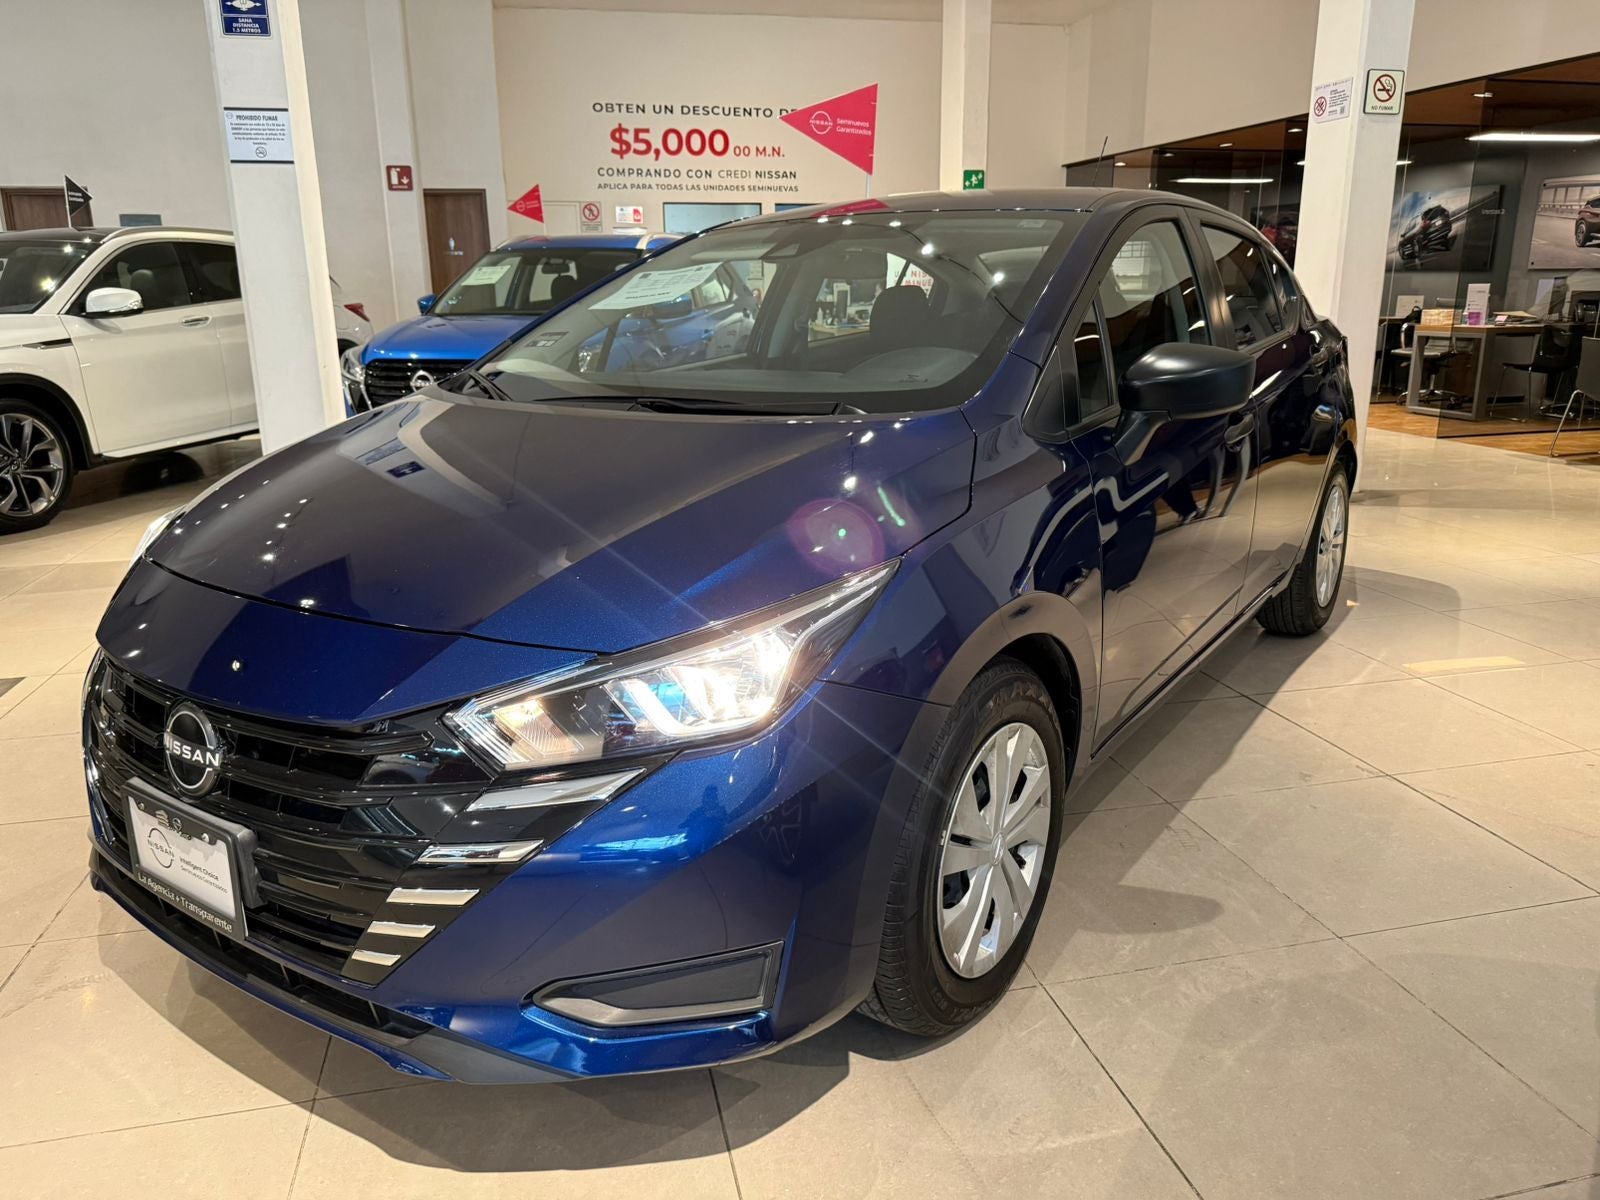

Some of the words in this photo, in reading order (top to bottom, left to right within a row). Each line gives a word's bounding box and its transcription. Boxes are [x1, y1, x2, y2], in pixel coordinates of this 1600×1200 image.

[592, 102, 646, 114] OBTEN
[652, 104, 674, 115] UN
[680, 105, 773, 118] DESCUENTO
[809, 119, 833, 127] NISSAN
[836, 118, 870, 128] Seminuevos
[836, 126, 872, 136] Garantizados
[609, 122, 730, 161] $5,000
[733, 145, 750, 157] 00
[755, 145, 785, 157] M.N.
[597, 167, 681, 178] COMPRANDO
[686, 169, 712, 179] CON
[717, 169, 751, 179] CREDI
[755, 170, 797, 179] NISSAN
[164, 732, 219, 767] NISSAN
[147, 838, 174, 859] NISSAN
[138, 872, 147, 884] La
[147, 878, 175, 901] Agencia
[180, 896, 233, 933] Transparente
